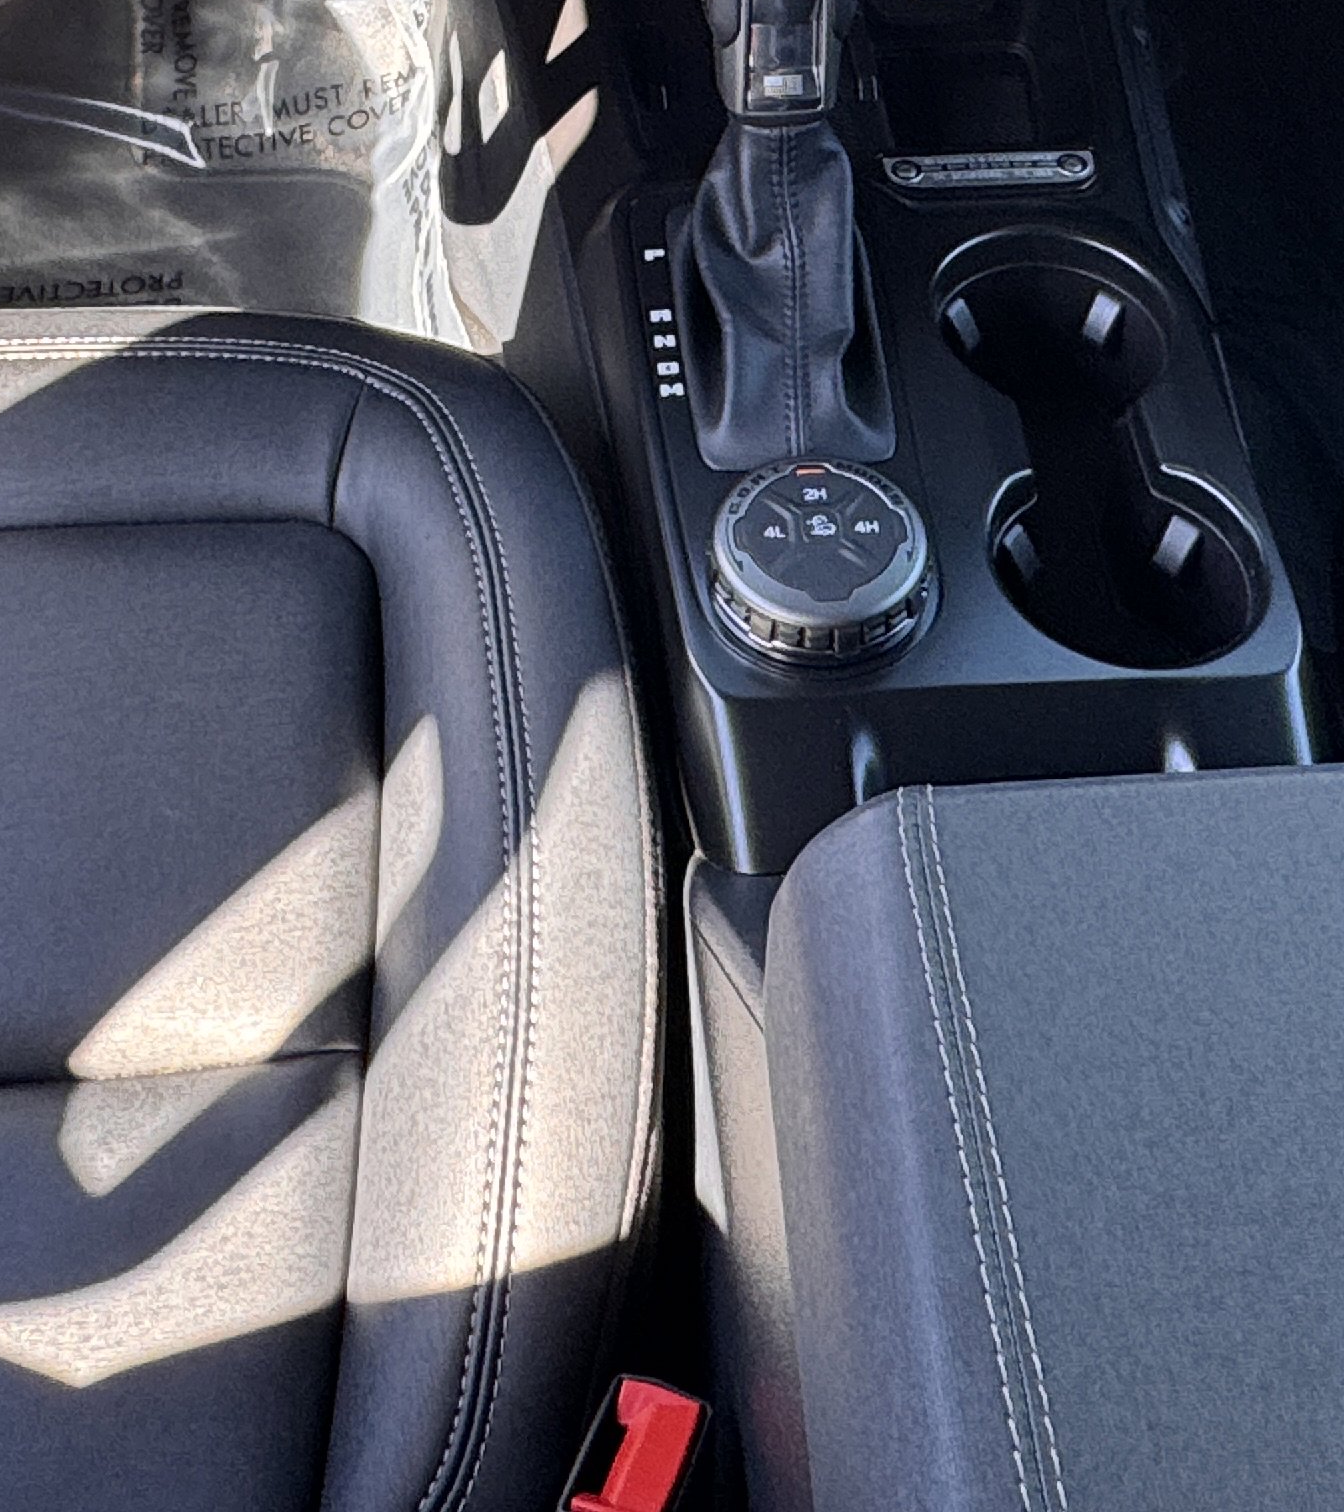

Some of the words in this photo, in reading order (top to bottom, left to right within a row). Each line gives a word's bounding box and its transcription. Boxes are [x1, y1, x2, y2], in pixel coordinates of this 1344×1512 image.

[273, 83, 344, 121] MUST
[802, 487, 827, 501] 2H
[763, 525, 786, 539] 4L
[854, 520, 880, 534] 4H
